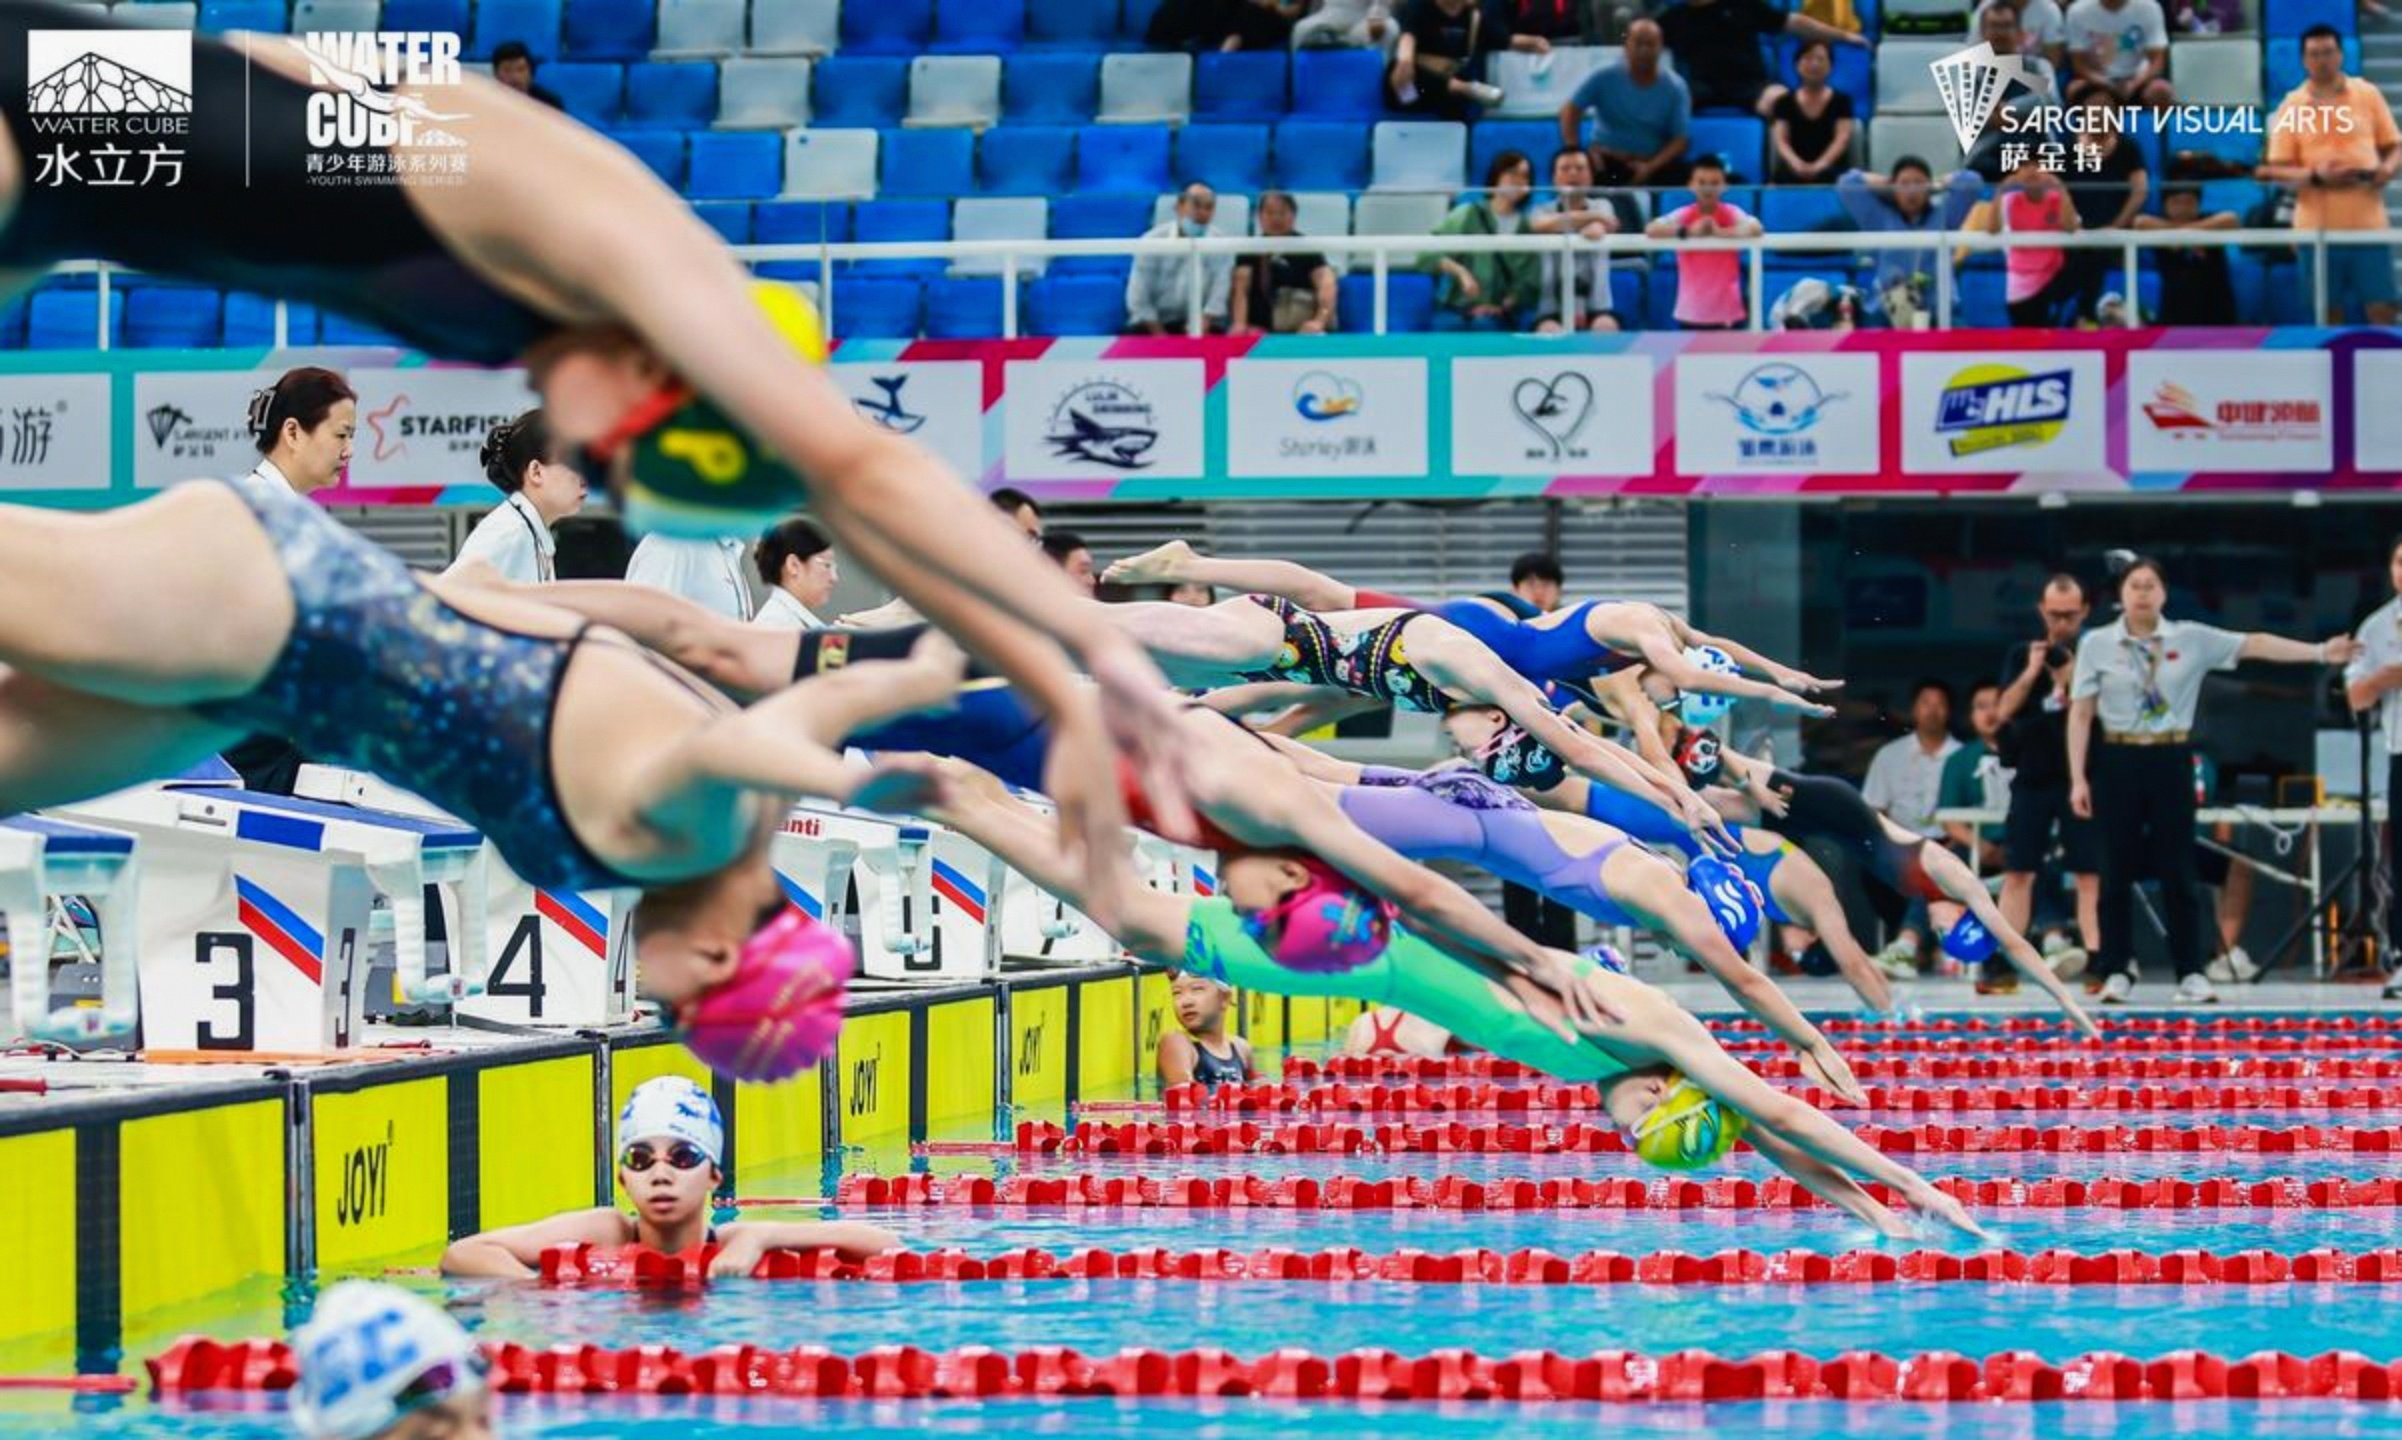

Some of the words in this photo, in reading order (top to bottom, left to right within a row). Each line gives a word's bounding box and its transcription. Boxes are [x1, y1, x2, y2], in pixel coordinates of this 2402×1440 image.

[0, 407, 53, 464] 游
[196, 931, 254, 1050] 3
[336, 927, 356, 1048] 3
[488, 914, 546, 1018] 4
[614, 911, 632, 1014] 4
[337, 1143, 387, 1228] JOYI
